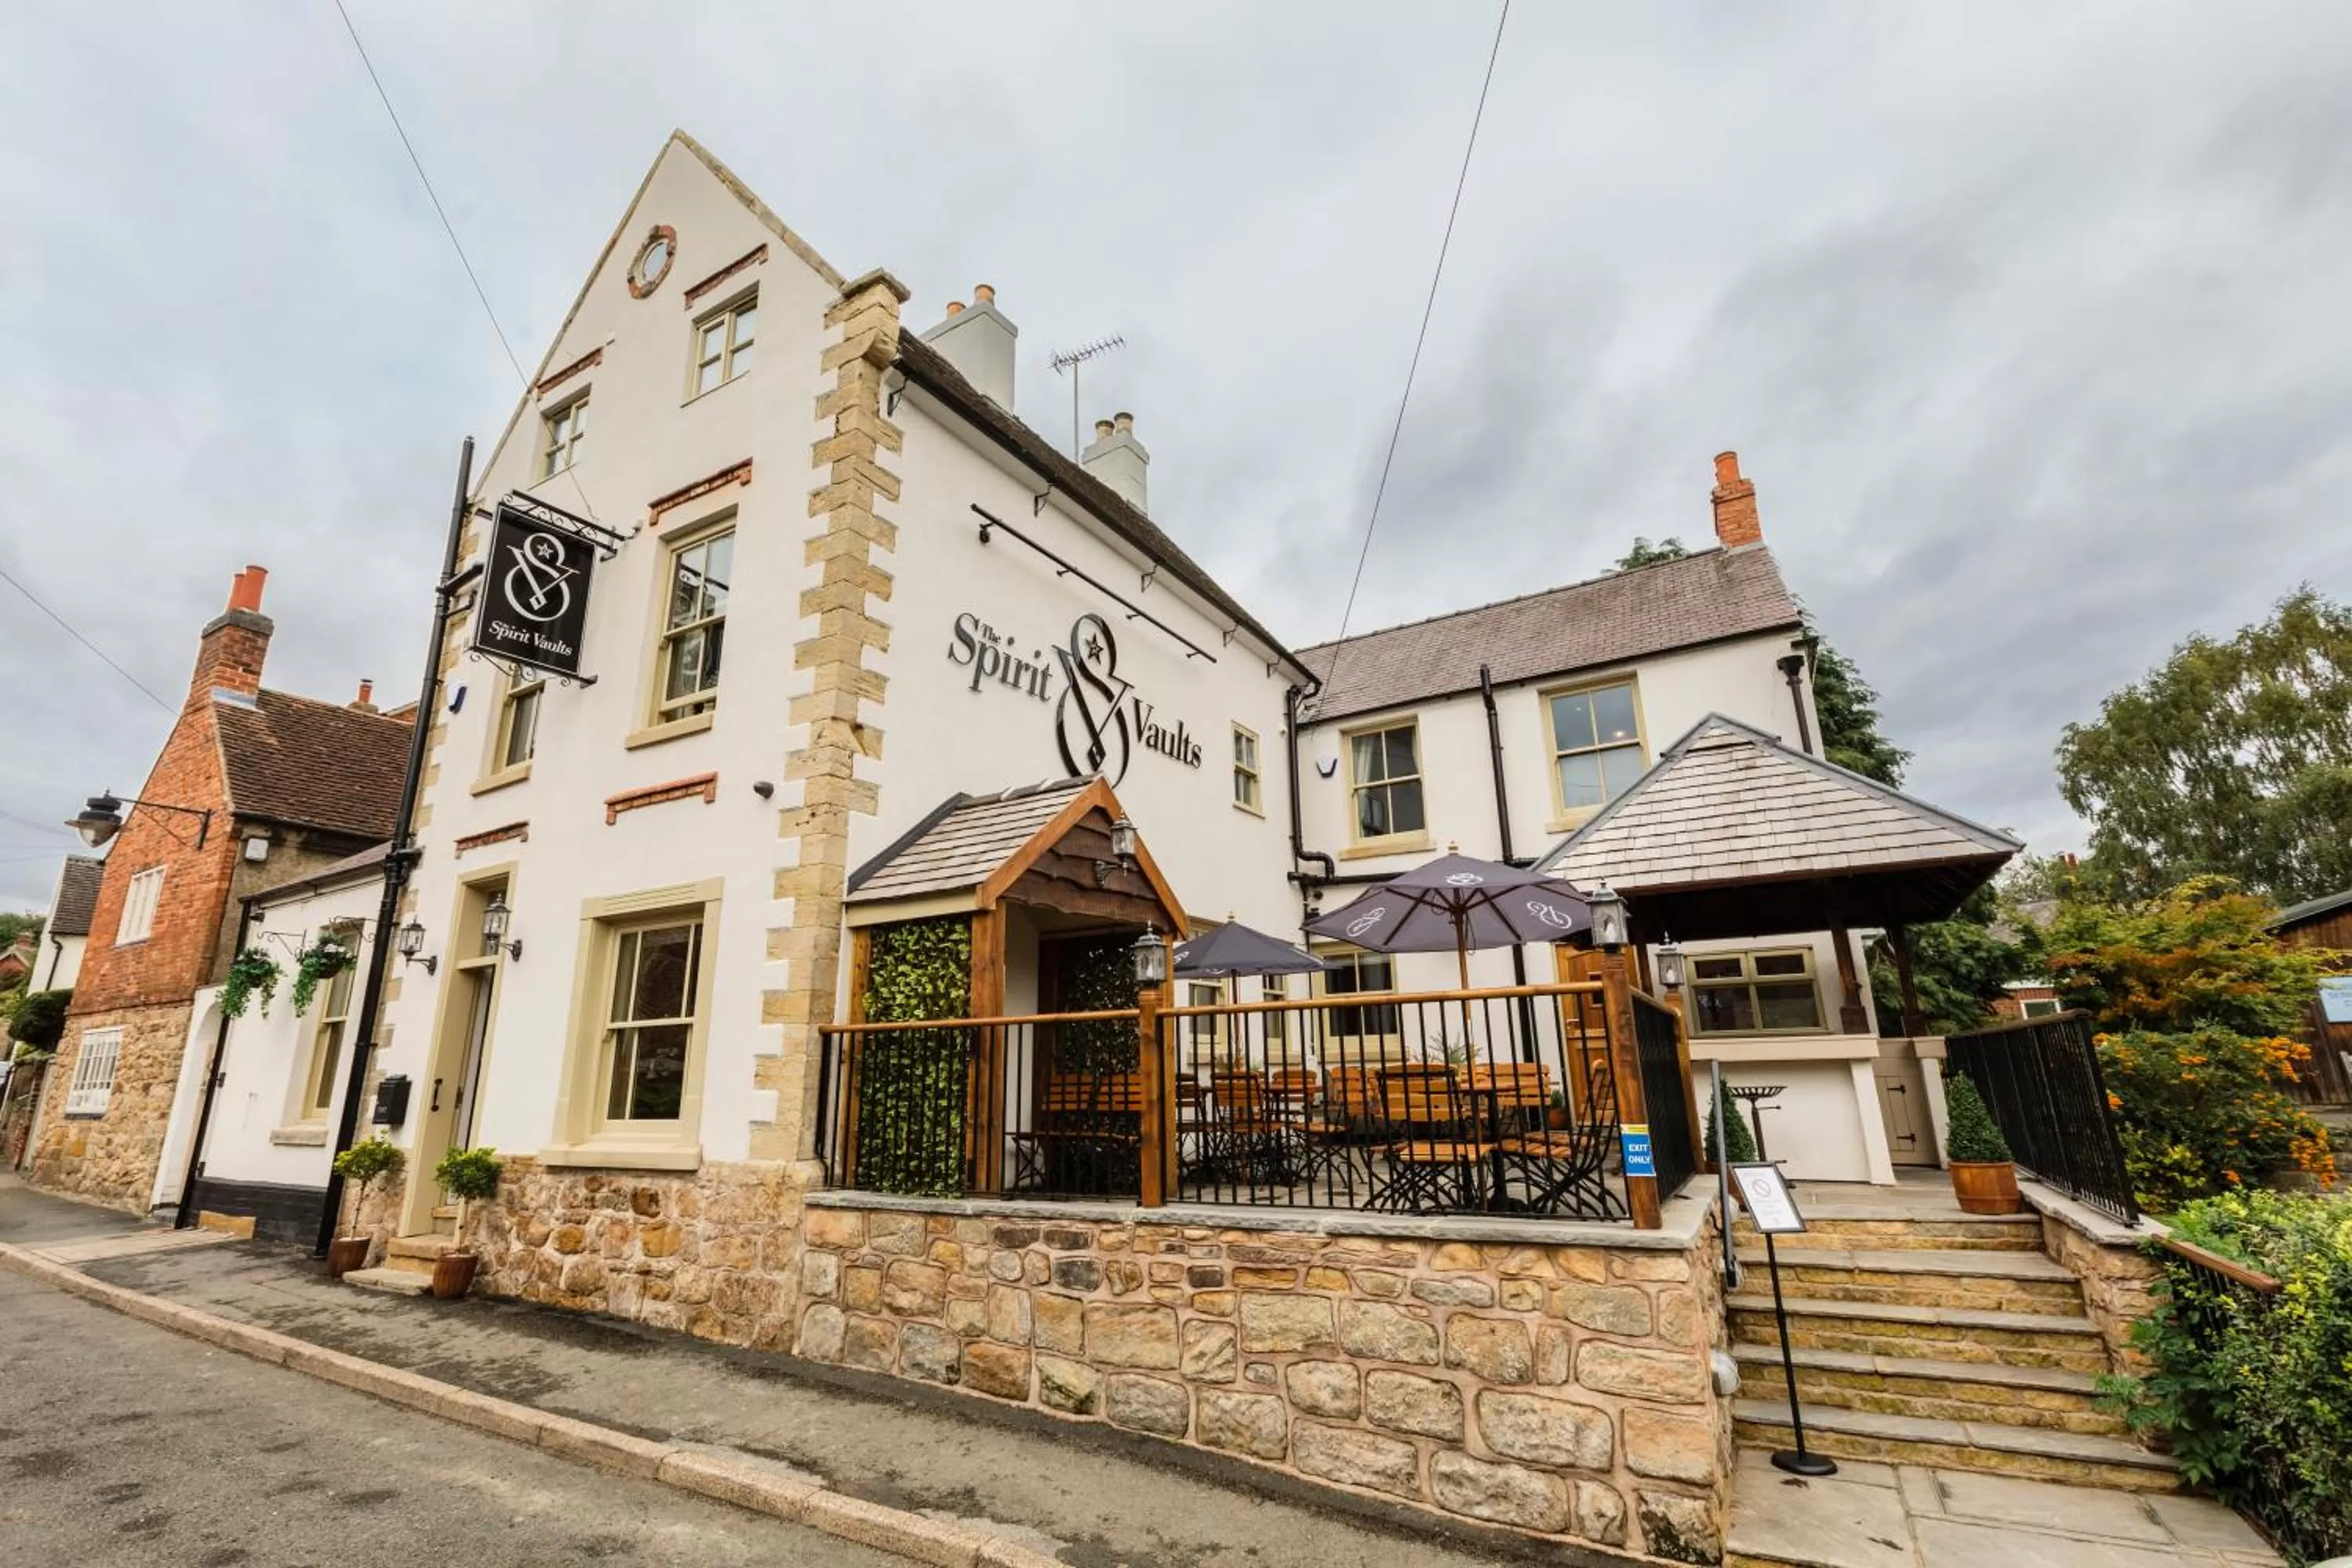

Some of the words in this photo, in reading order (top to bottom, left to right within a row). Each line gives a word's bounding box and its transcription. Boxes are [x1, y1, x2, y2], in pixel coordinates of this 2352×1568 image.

[488, 620, 531, 644] Spirit
[533, 631, 573, 656] Vaults
[981, 623, 1002, 644] The
[947, 612, 1054, 702] Spirit
[1131, 696, 1203, 770] Vaults
[1628, 1144, 1650, 1152] EXIT
[1628, 1155, 1650, 1164] ONLY
